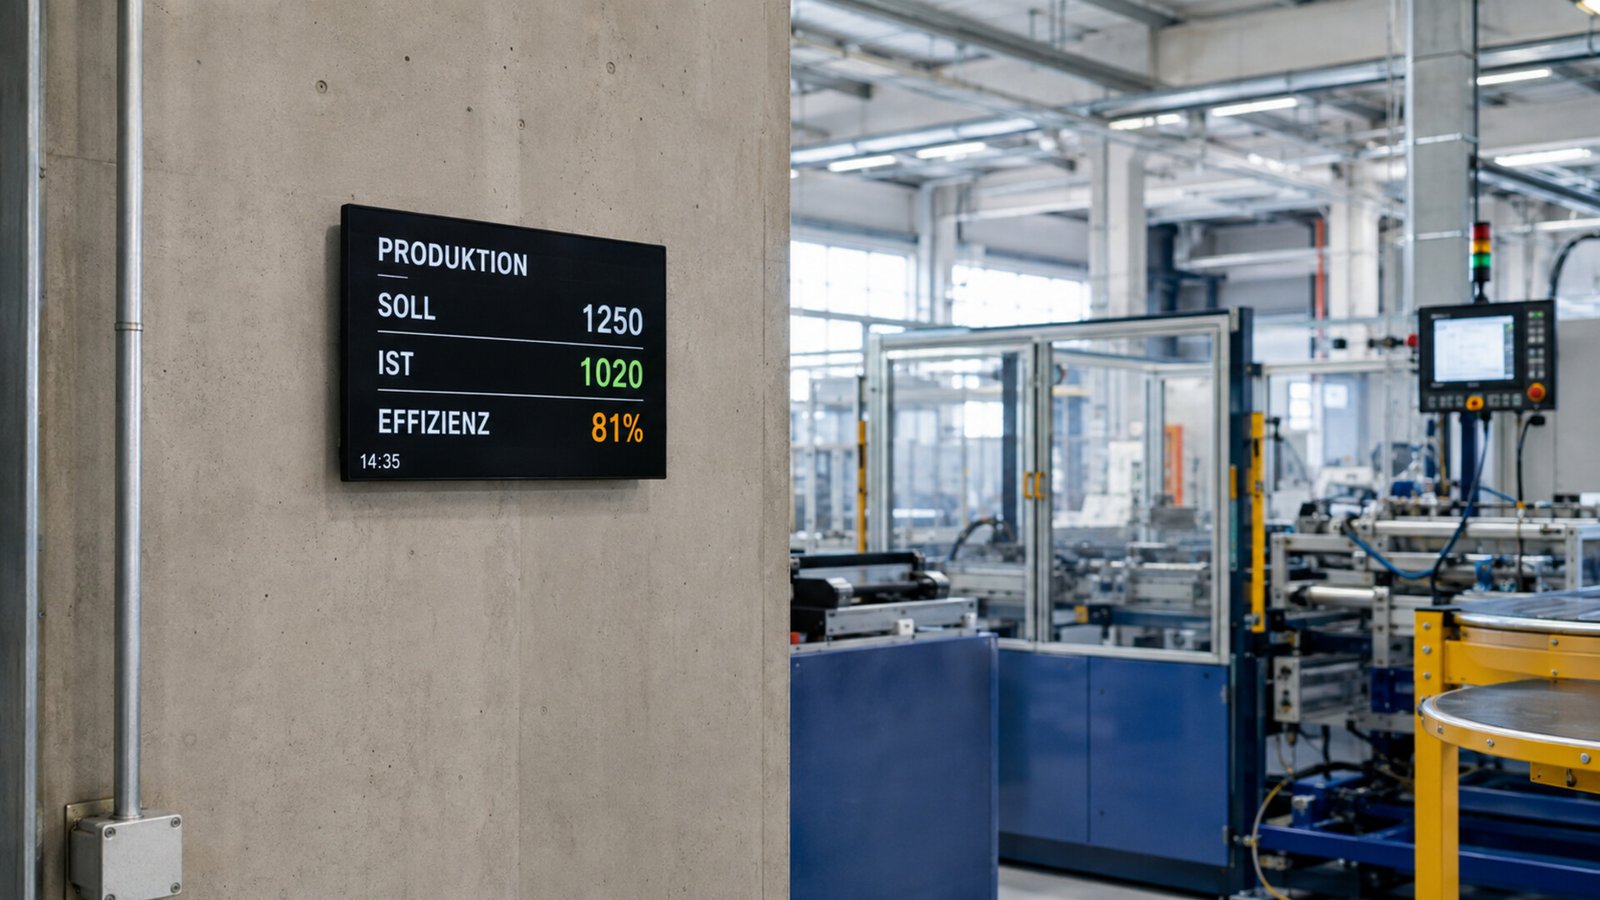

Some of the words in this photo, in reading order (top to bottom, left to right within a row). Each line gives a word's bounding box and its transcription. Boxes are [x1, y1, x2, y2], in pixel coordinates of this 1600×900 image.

[378, 237, 528, 277] PRODUKTION
[378, 292, 436, 321] SOLL
[582, 304, 643, 336] 1250
[378, 350, 414, 376] IST
[580, 356, 643, 389] 1020
[378, 408, 490, 436] EFFIZIENZ
[591, 412, 644, 443] 81%
[360, 453, 401, 469] 14:35
